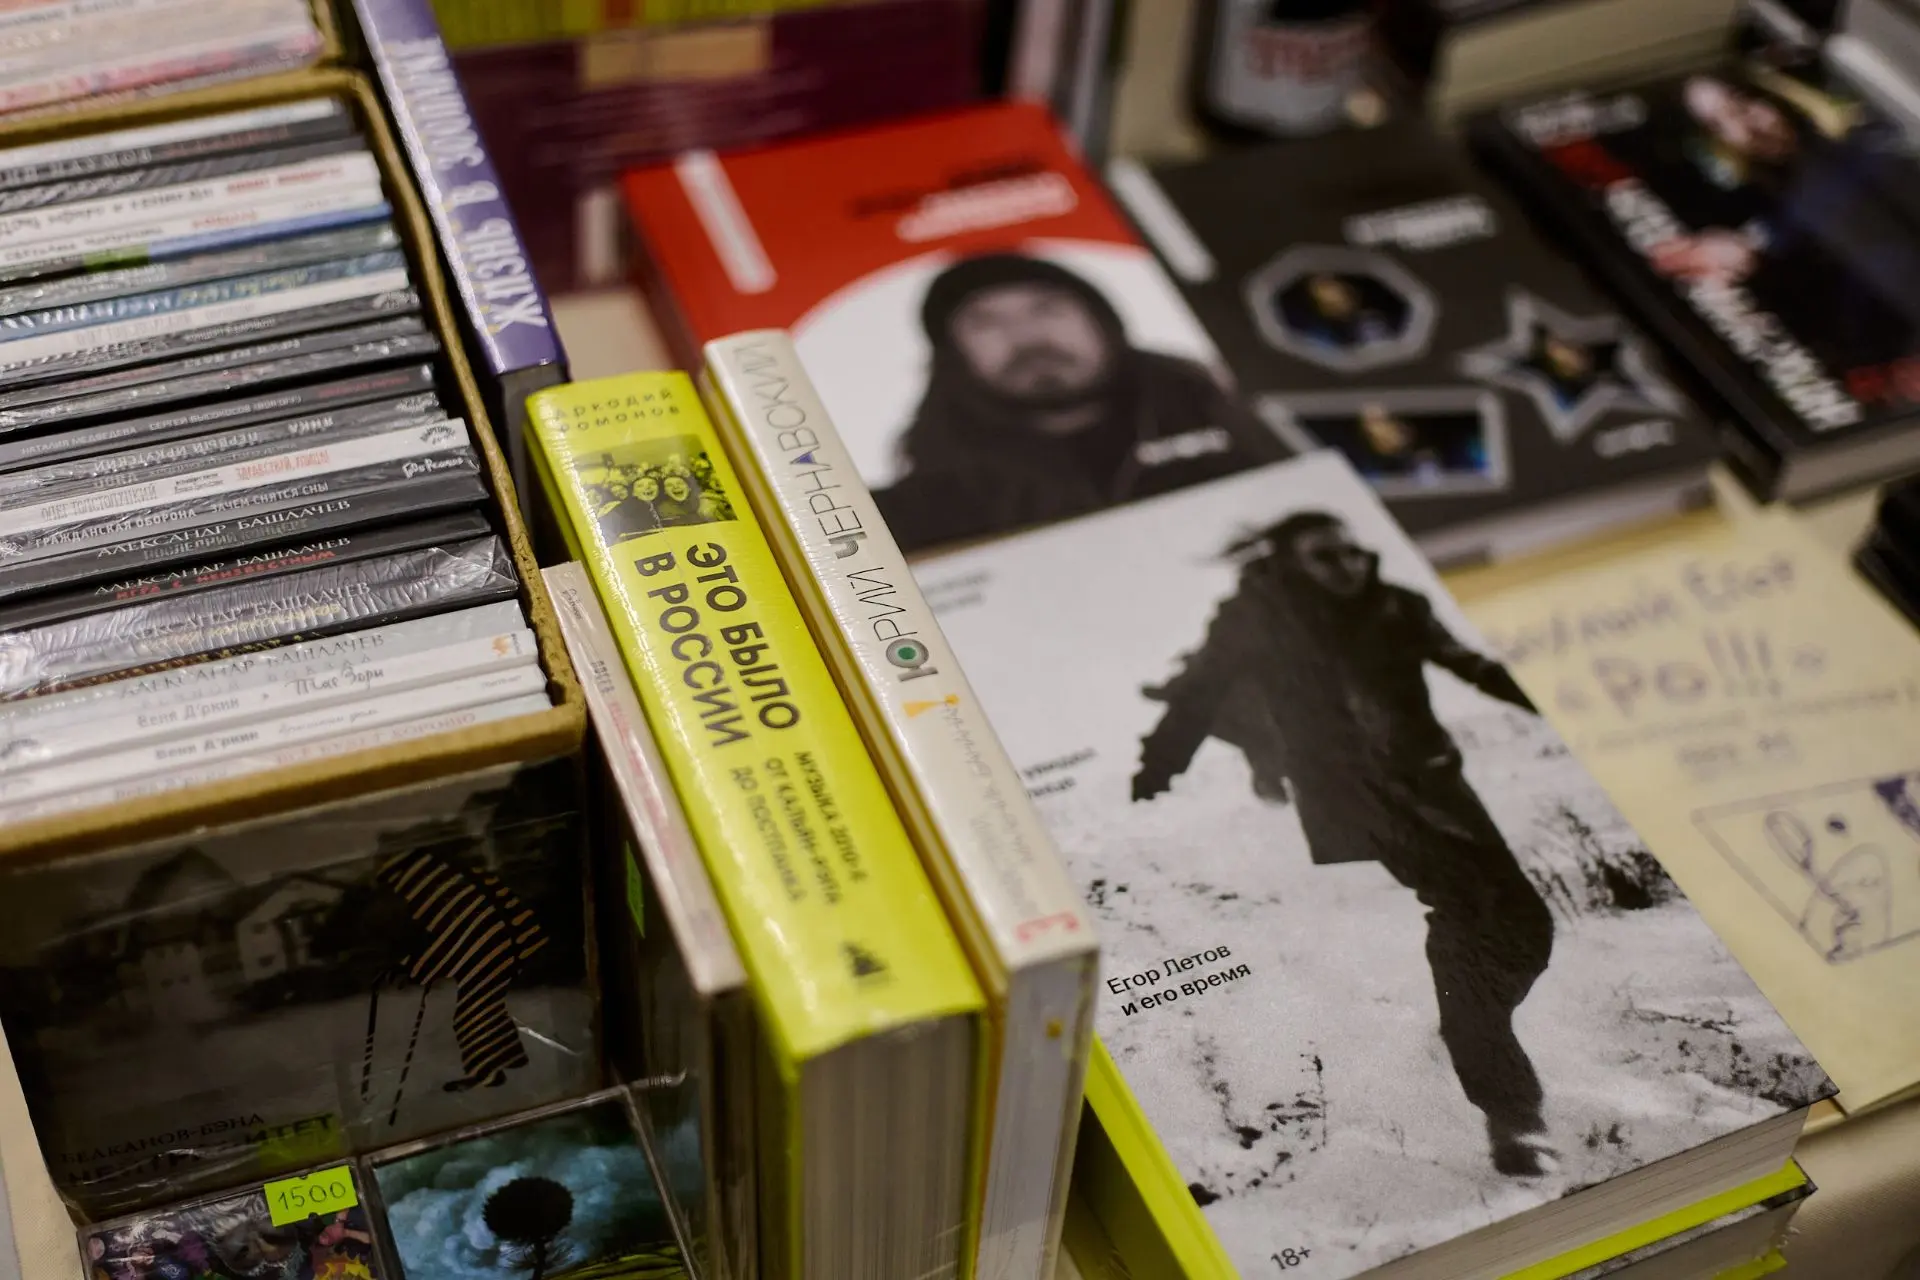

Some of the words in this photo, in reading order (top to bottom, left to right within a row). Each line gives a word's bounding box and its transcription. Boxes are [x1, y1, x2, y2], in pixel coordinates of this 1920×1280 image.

[445, 180, 499, 209] В
[458, 217, 548, 328] ЖИЗНЬ
[287, 416, 334, 434] ЯНКА
[34, 519, 134, 549] ГРАЖДАНСКАЯ
[135, 508, 198, 530] ОБОРОНА
[211, 496, 251, 514] ЗАЧЕМ
[254, 487, 300, 506] СНЯТСЯ
[302, 480, 329, 496] СНЫ
[97, 524, 228, 559] АЛЕКСАНДР
[236, 499, 352, 531] БАШЛАЧЕВ
[94, 561, 226, 597] АЛЕКСАНДР
[235, 536, 352, 568] БАШЛАЧЕВ
[634, 551, 677, 577] В
[253, 581, 373, 617] БАШЛАЧЕВ
[686, 542, 748, 612] ЭТО
[719, 621, 801, 730] БЫЛО
[846, 566, 939, 683] ЮРИЙ
[266, 633, 385, 669] БАШЛАЧЕВ
[647, 582, 752, 748] РОССИИ
[136, 709, 178, 730] Веня
[729, 766, 758, 792] ДО
[764, 756, 789, 779] ОТ
[793, 750, 839, 823] МУЗЫКА
[1106, 967, 1161, 996] Егор
[1162, 945, 1232, 977] Летов
[1121, 1001, 1139, 1018] и
[1140, 988, 1179, 1010] его
[1180, 962, 1252, 996] время
[277, 1178, 347, 1213] 1500
[1270, 1245, 1311, 1271] 18+
